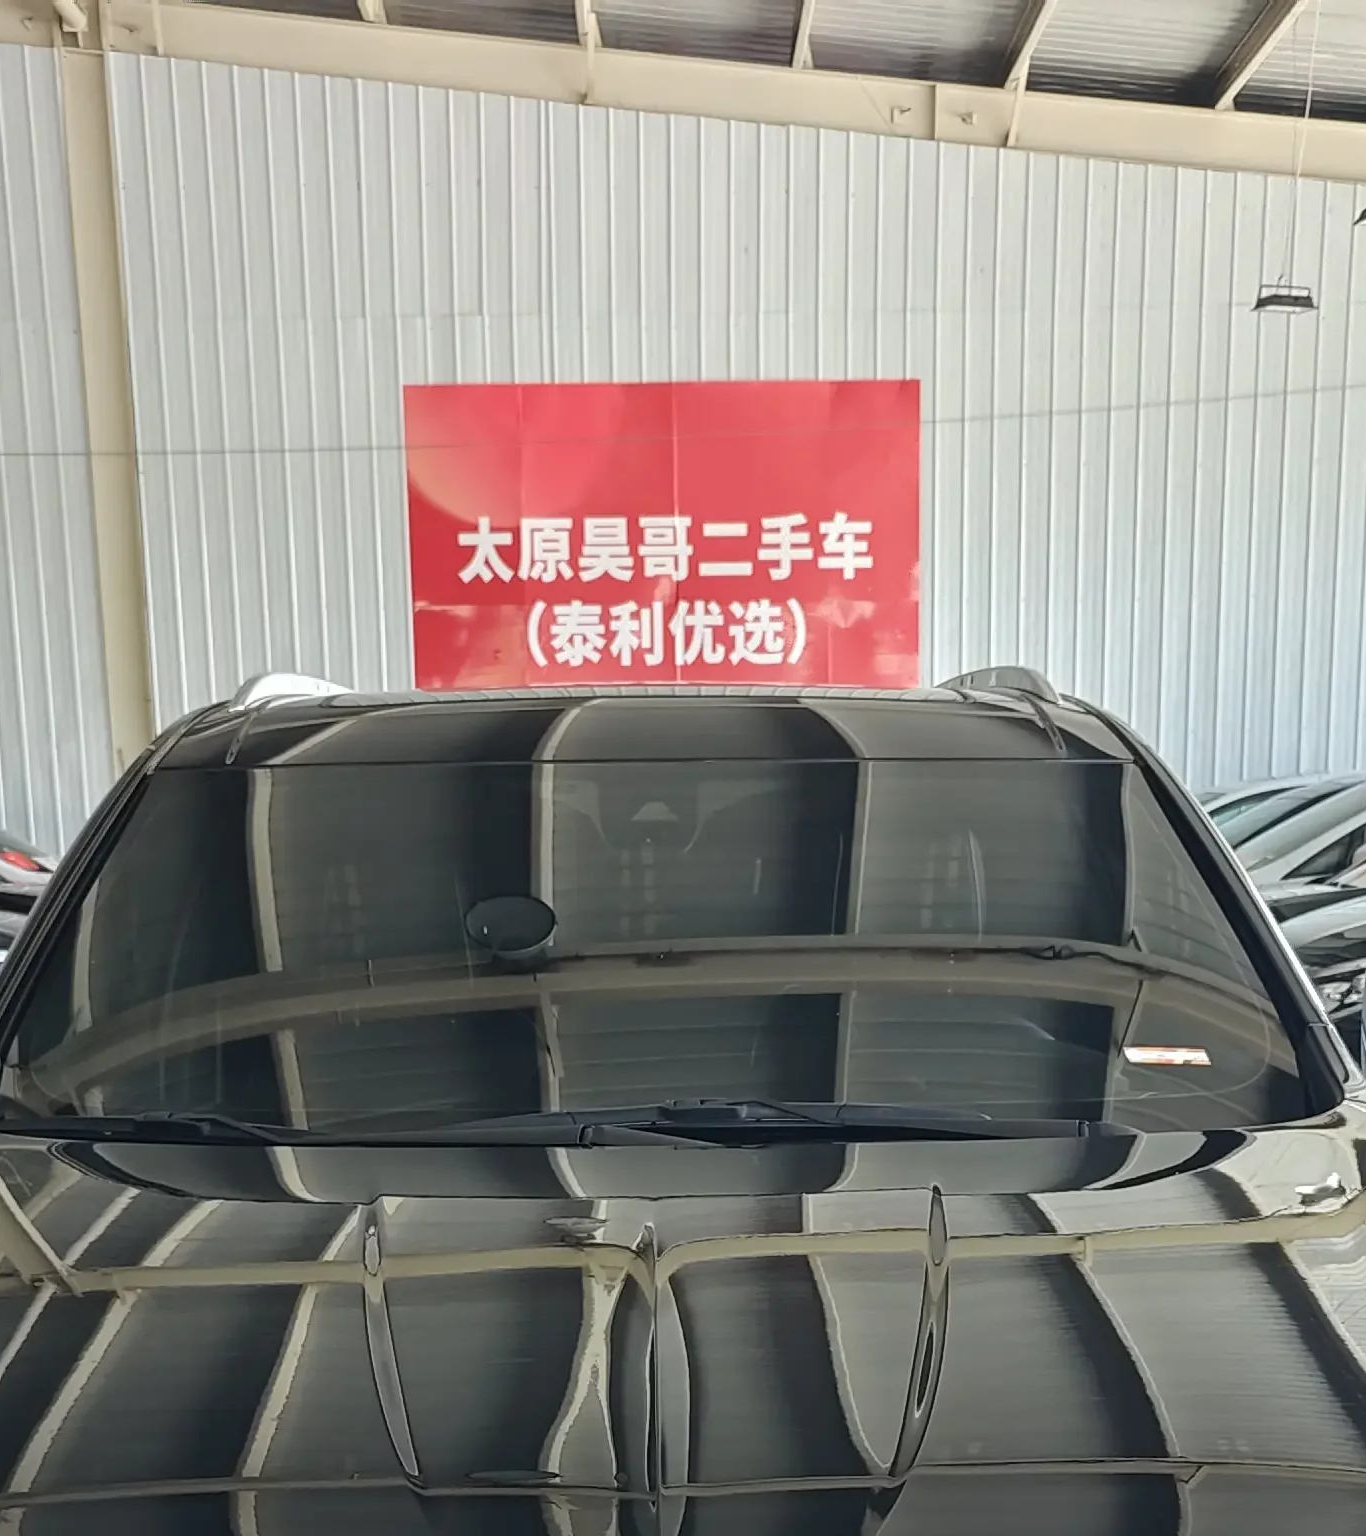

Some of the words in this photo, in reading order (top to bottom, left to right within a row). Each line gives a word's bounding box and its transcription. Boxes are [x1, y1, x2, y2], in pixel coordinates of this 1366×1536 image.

[458, 511, 874, 583] 太原昊哥二手车
[527, 598, 806, 667] (泰利优选)
